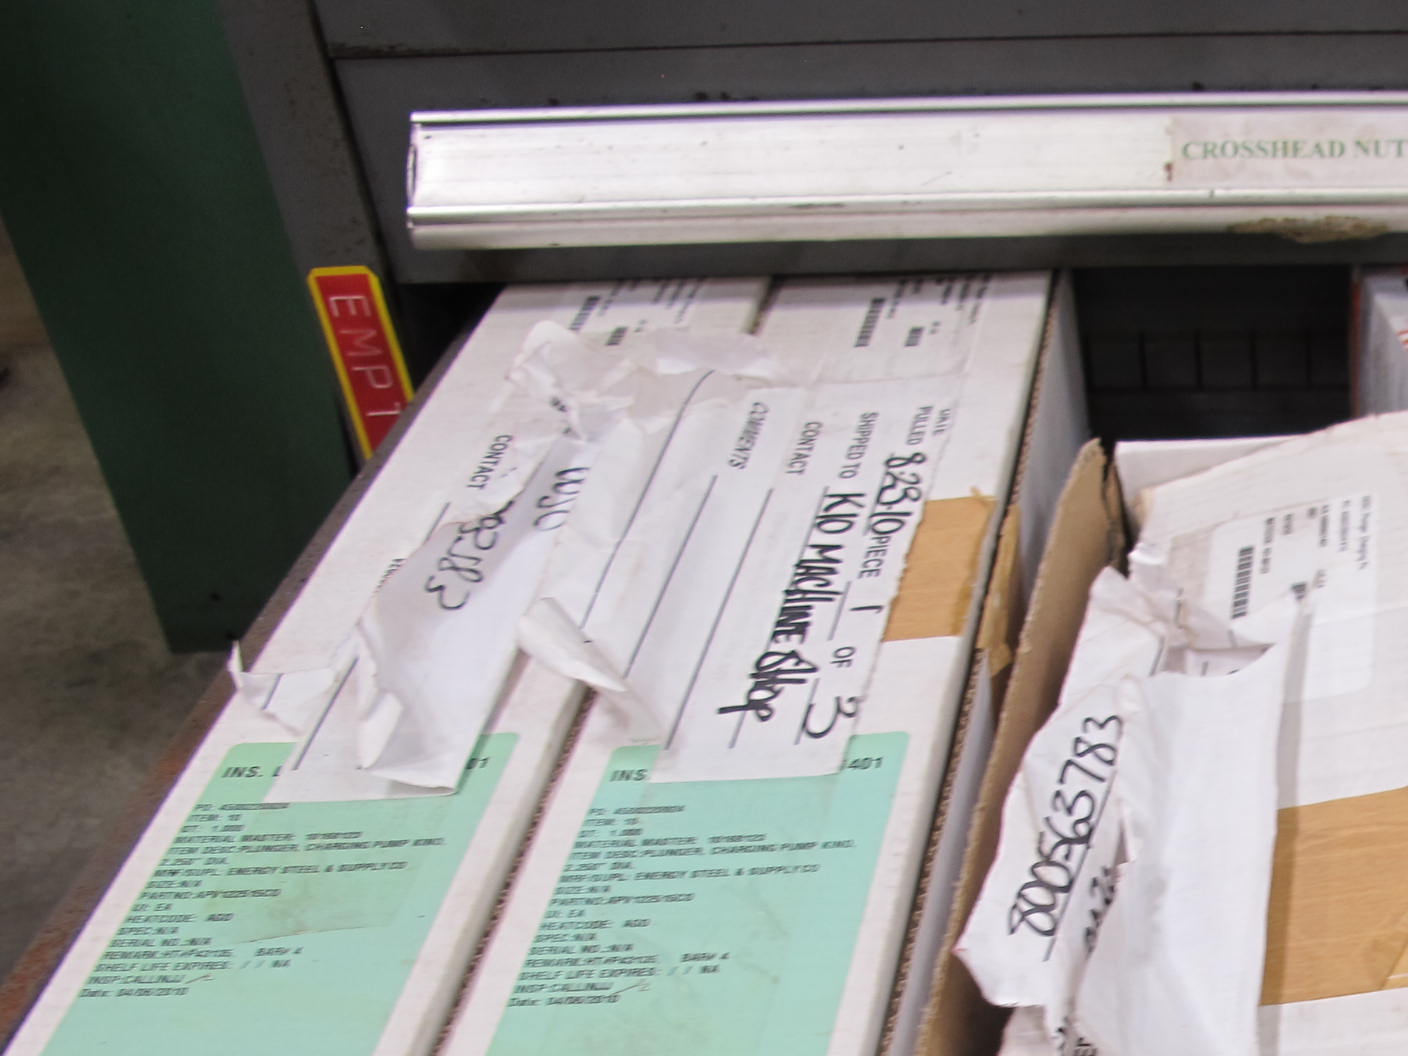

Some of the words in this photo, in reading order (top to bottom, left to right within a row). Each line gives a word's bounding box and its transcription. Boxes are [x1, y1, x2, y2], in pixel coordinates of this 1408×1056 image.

[1181, 139, 1346, 161] CROSSHEAD
[1354, 138, 1408, 159] NUT
[728, 402, 769, 469] COMMENTS
[846, 412, 879, 460] SHIPPED
[907, 406, 933, 445] PULLED
[467, 435, 513, 490] CONTACT
[786, 422, 823, 475] CONTACT
[838, 462, 861, 479] TO
[858, 535, 890, 579] PIECE
[830, 646, 855, 668] OF
[221, 766, 263, 778] INS.
